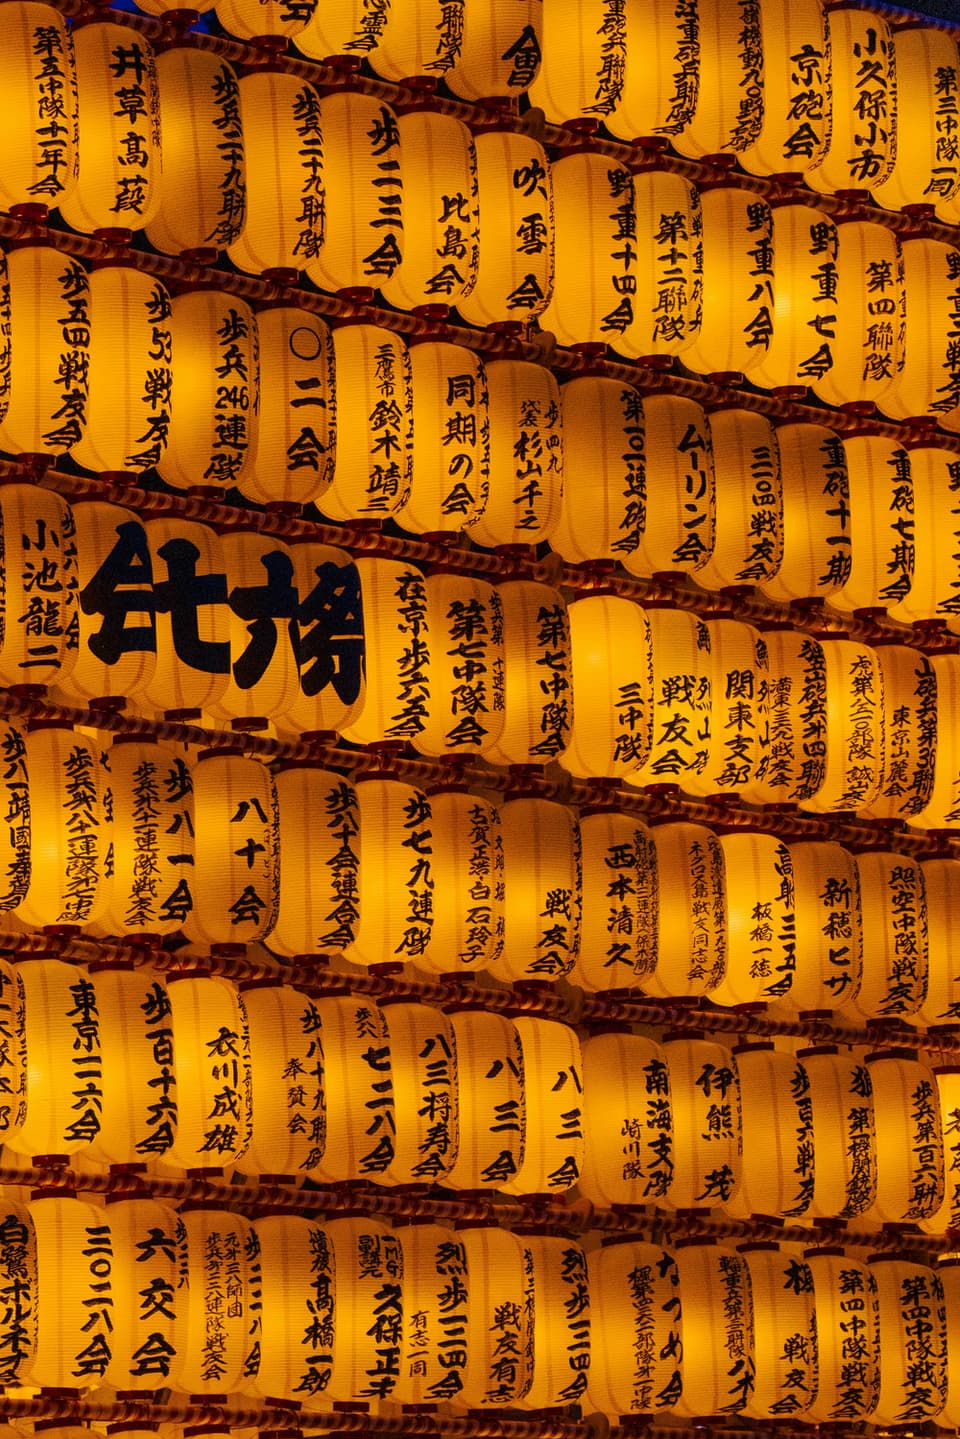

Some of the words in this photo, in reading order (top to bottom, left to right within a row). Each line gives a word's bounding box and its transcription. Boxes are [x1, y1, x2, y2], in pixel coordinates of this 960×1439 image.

[847, 28, 889, 183] 小久保小市
[424, 194, 469, 296] 比島会
[506, 162, 548, 310] 吹雪会
[598, 168, 638, 336] 野重十四会
[652, 213, 689, 341] 第十二聯隊
[744, 202, 775, 350] 野重八会
[797, 221, 840, 380] 野重七会
[862, 258, 896, 384] 第四聯隊
[440, 374, 478, 518] 同期の会
[673, 422, 713, 564] ムーリン会
[18, 518, 65, 667] 小池龍二
[445, 599, 490, 749] 第七中隊会
[528, 604, 571, 756] 第七中隊会
[613, 680, 647, 764] 三中隊
[649, 673, 692, 776] 戦友会
[714, 670, 754, 788] 関東支部
[158, 757, 196, 924] 歩八一会
[230, 797, 269, 926] 八十会
[393, 791, 436, 957] 歩七九連隊
[602, 842, 637, 968] 西本清久
[524, 888, 573, 976] 戦友会
[62, 976, 104, 1143] 東京二六会
[134, 983, 178, 1156] 歩百十六会
[198, 1026, 243, 1156] 衣川成雄
[479, 1057, 522, 1183] 八三会
[547, 1063, 586, 1189] 八三会
[694, 1061, 737, 1202] 伊熊茂
[70, 1224, 115, 1378] 三〇二八会
[130, 1226, 179, 1378] 六交会
[403, 1310, 431, 1379] 有志一同
[765, 1330, 811, 1416] 戦友会
